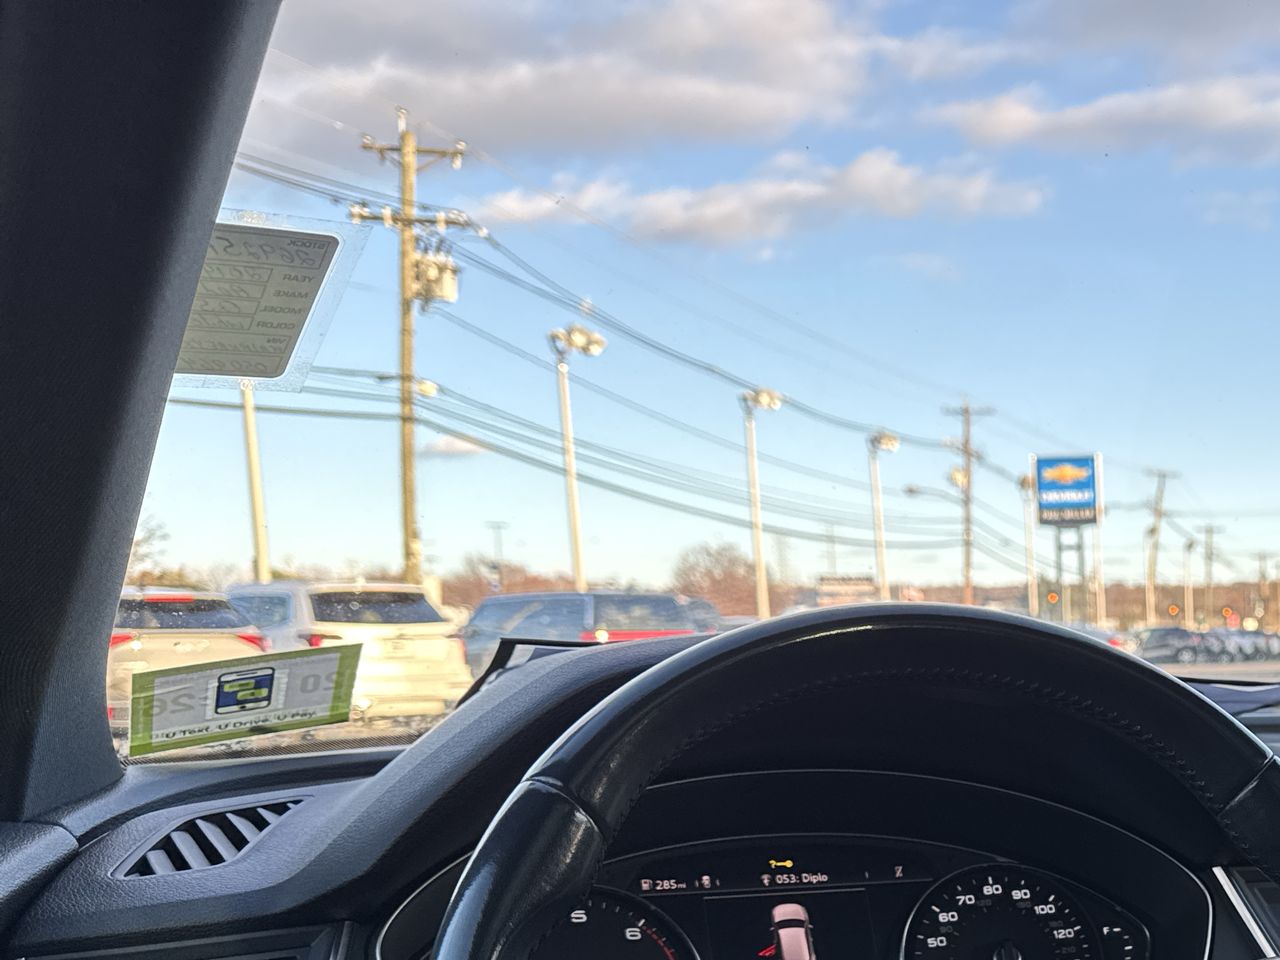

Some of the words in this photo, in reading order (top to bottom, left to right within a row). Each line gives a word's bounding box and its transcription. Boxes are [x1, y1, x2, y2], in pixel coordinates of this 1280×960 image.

[775, 874, 801, 885] 053:
[801, 872, 829, 886] Diplo
[982, 883, 1003, 896] 80
[1011, 888, 1031, 900] 90
[955, 894, 976, 906] 70
[570, 909, 588, 923] 5
[1033, 903, 1056, 916] 100
[938, 911, 959, 923] 60
[625, 927, 642, 941] 6
[1052, 927, 1076, 940] 120
[1102, 926, 1111, 935] F
[926, 936, 948, 948] 50
